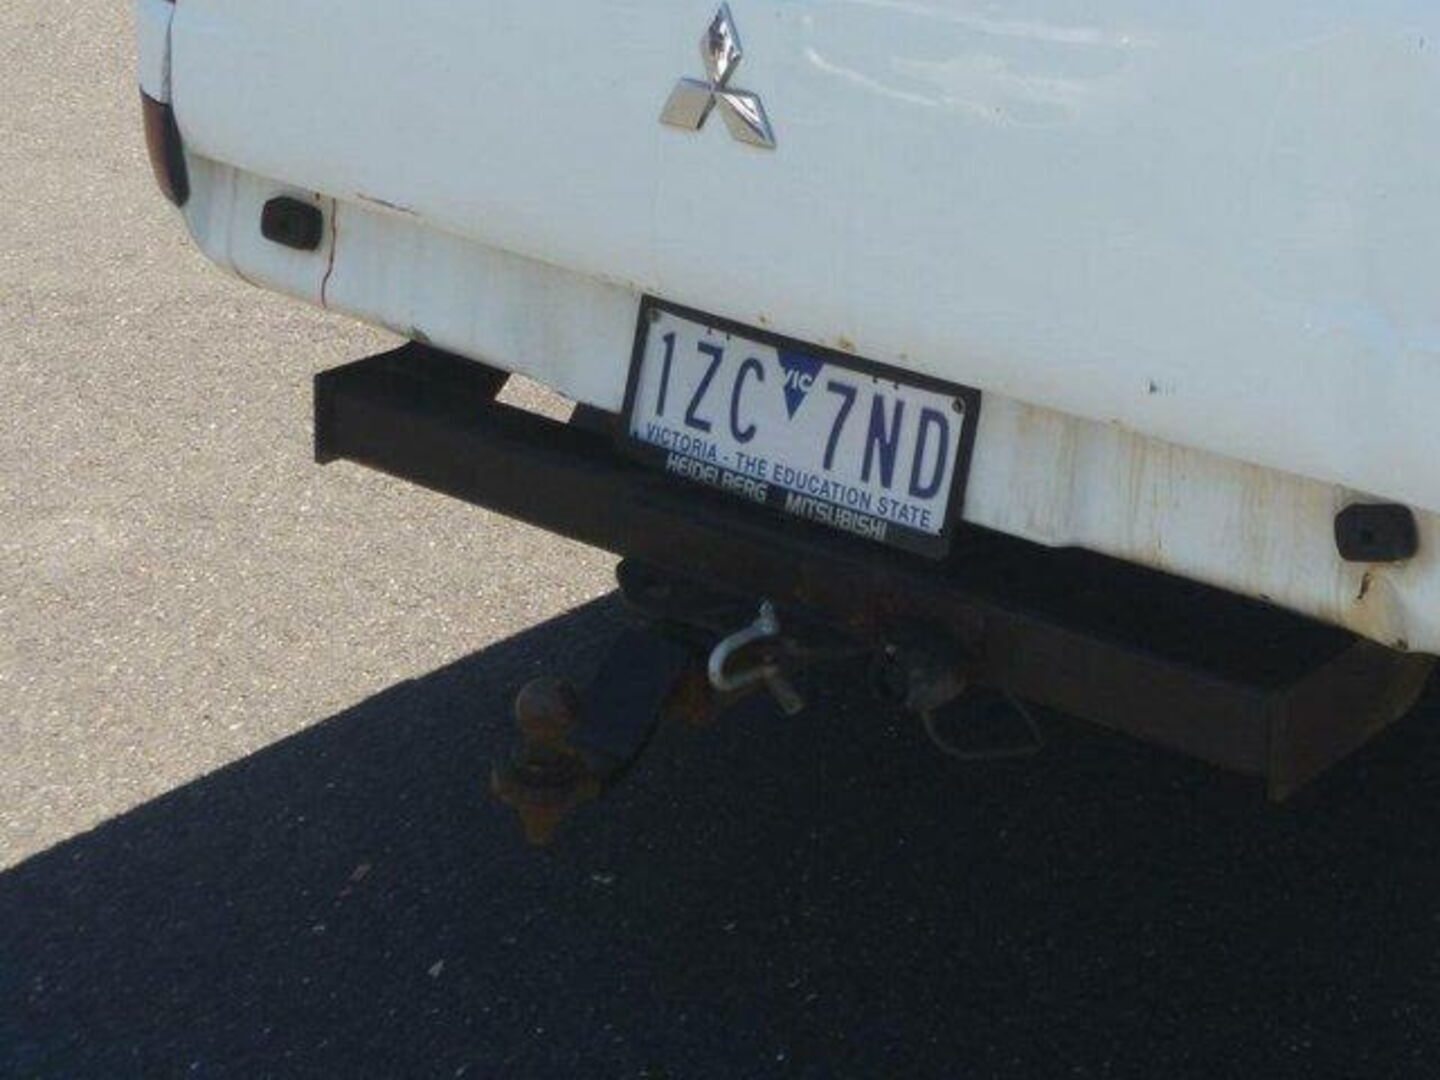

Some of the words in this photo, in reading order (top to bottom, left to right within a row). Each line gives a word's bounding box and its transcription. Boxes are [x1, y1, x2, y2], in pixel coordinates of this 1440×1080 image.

[656, 331, 765, 444] 1ZC
[823, 380, 949, 499] 7ND
[785, 369, 813, 391] VIC
[647, 423, 717, 461] VICTORIA
[735, 451, 768, 480] THE
[773, 464, 872, 510] EDUCATION
[877, 497, 932, 529] STATE
[665, 452, 768, 503] HEIDELBERG
[784, 491, 888, 542] MITSUBISHI
